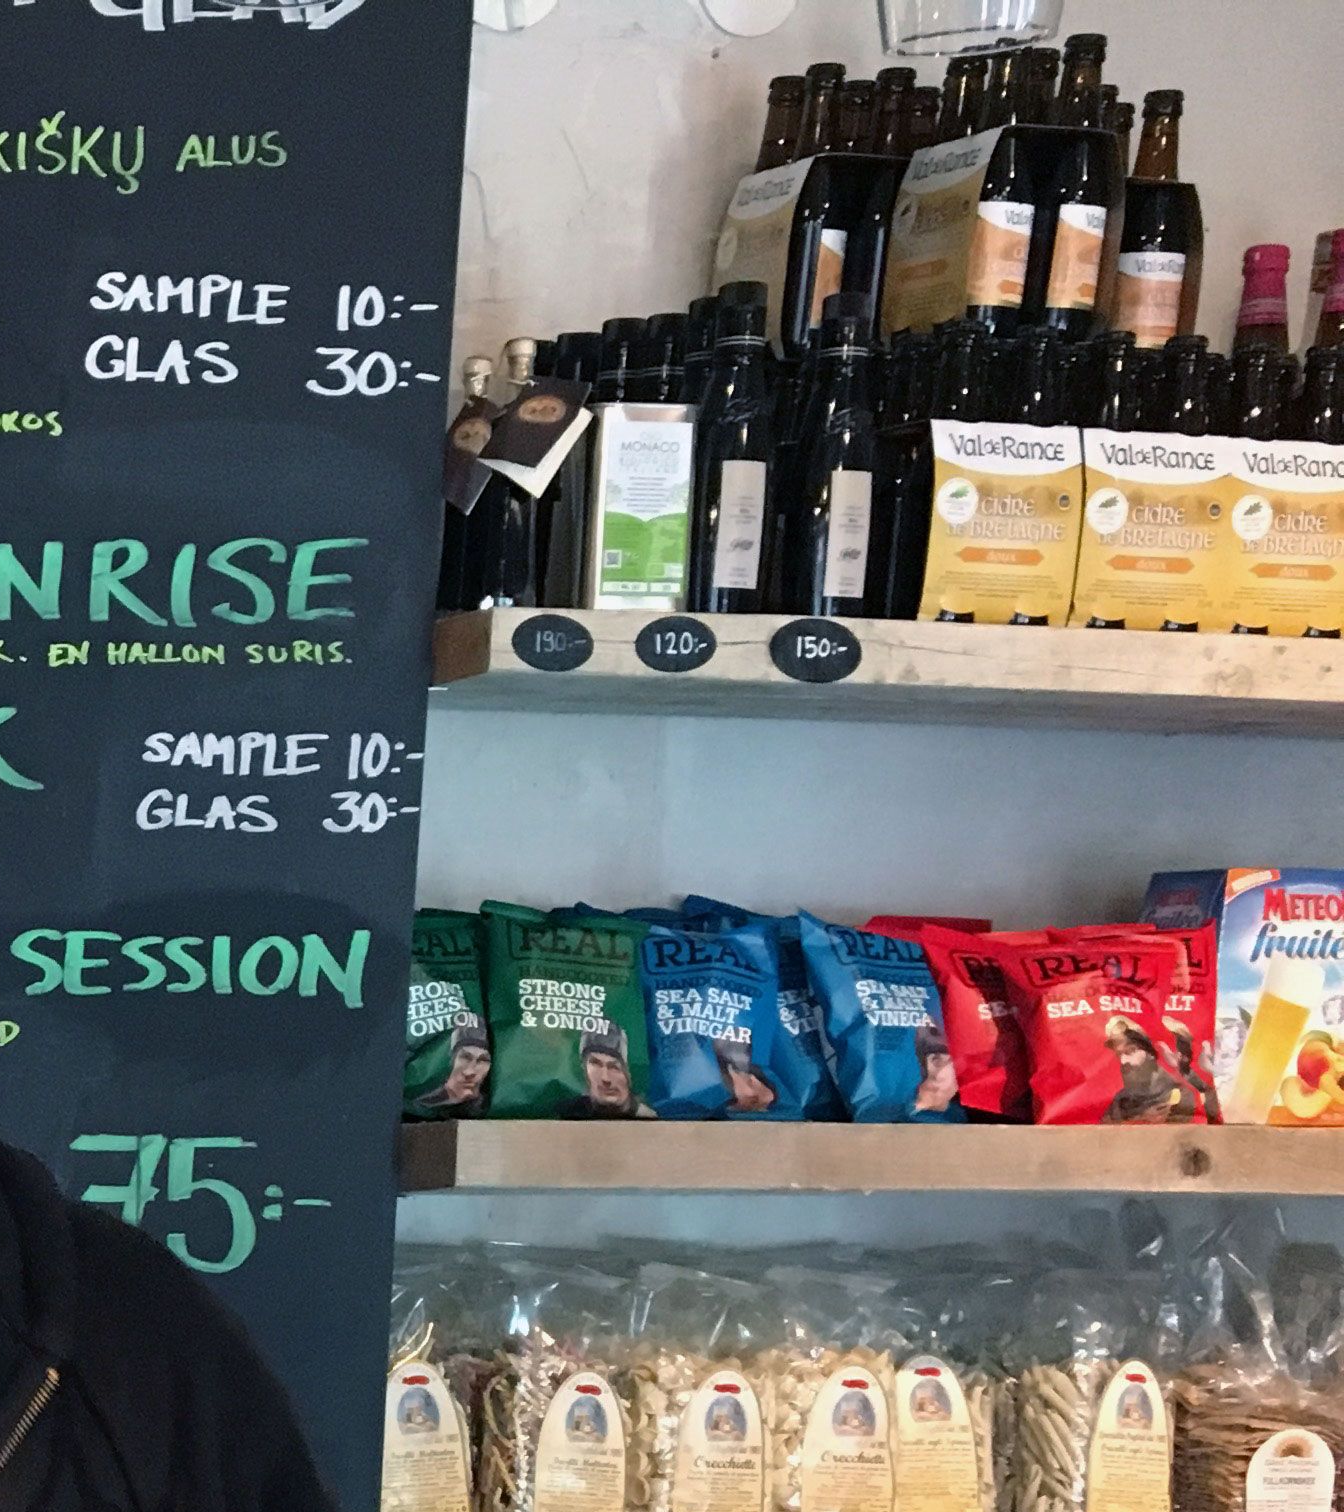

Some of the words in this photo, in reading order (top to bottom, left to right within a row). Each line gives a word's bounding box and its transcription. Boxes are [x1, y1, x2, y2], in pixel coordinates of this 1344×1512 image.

[176, 130, 288, 173] ALUS
[89, 270, 292, 327] SAMPLE
[335, 283, 440, 333] 10:-
[84, 334, 241, 386] GLAS
[305, 346, 442, 397] 30:-
[620, 440, 681, 454] MONACO
[48, 638, 90, 668] EN
[107, 639, 226, 665] HALLON
[247, 639, 354, 666] SURIS.
[653, 631, 709, 656] 120:-
[794, 634, 848, 659] 150:-
[141, 732, 330, 778] SAMPLE
[134, 787, 279, 833] GLAS
[1263, 888, 1344, 922] METEO
[10, 927, 372, 1010] SESSION
[518, 978, 607, 1002] STRONG
[654, 987, 703, 1004] SEA
[707, 987, 754, 1012] SALT
[519, 995, 604, 1017] CHEESE
[656, 1003, 675, 1021] &
[682, 1003, 740, 1024] MALT
[1047, 998, 1095, 1019] SEA
[1099, 995, 1143, 1013] SALT
[411, 1011, 479, 1037] ONION
[520, 1011, 538, 1028] &
[543, 1013, 611, 1036] ONION
[657, 1019, 752, 1045] VINEGAR
